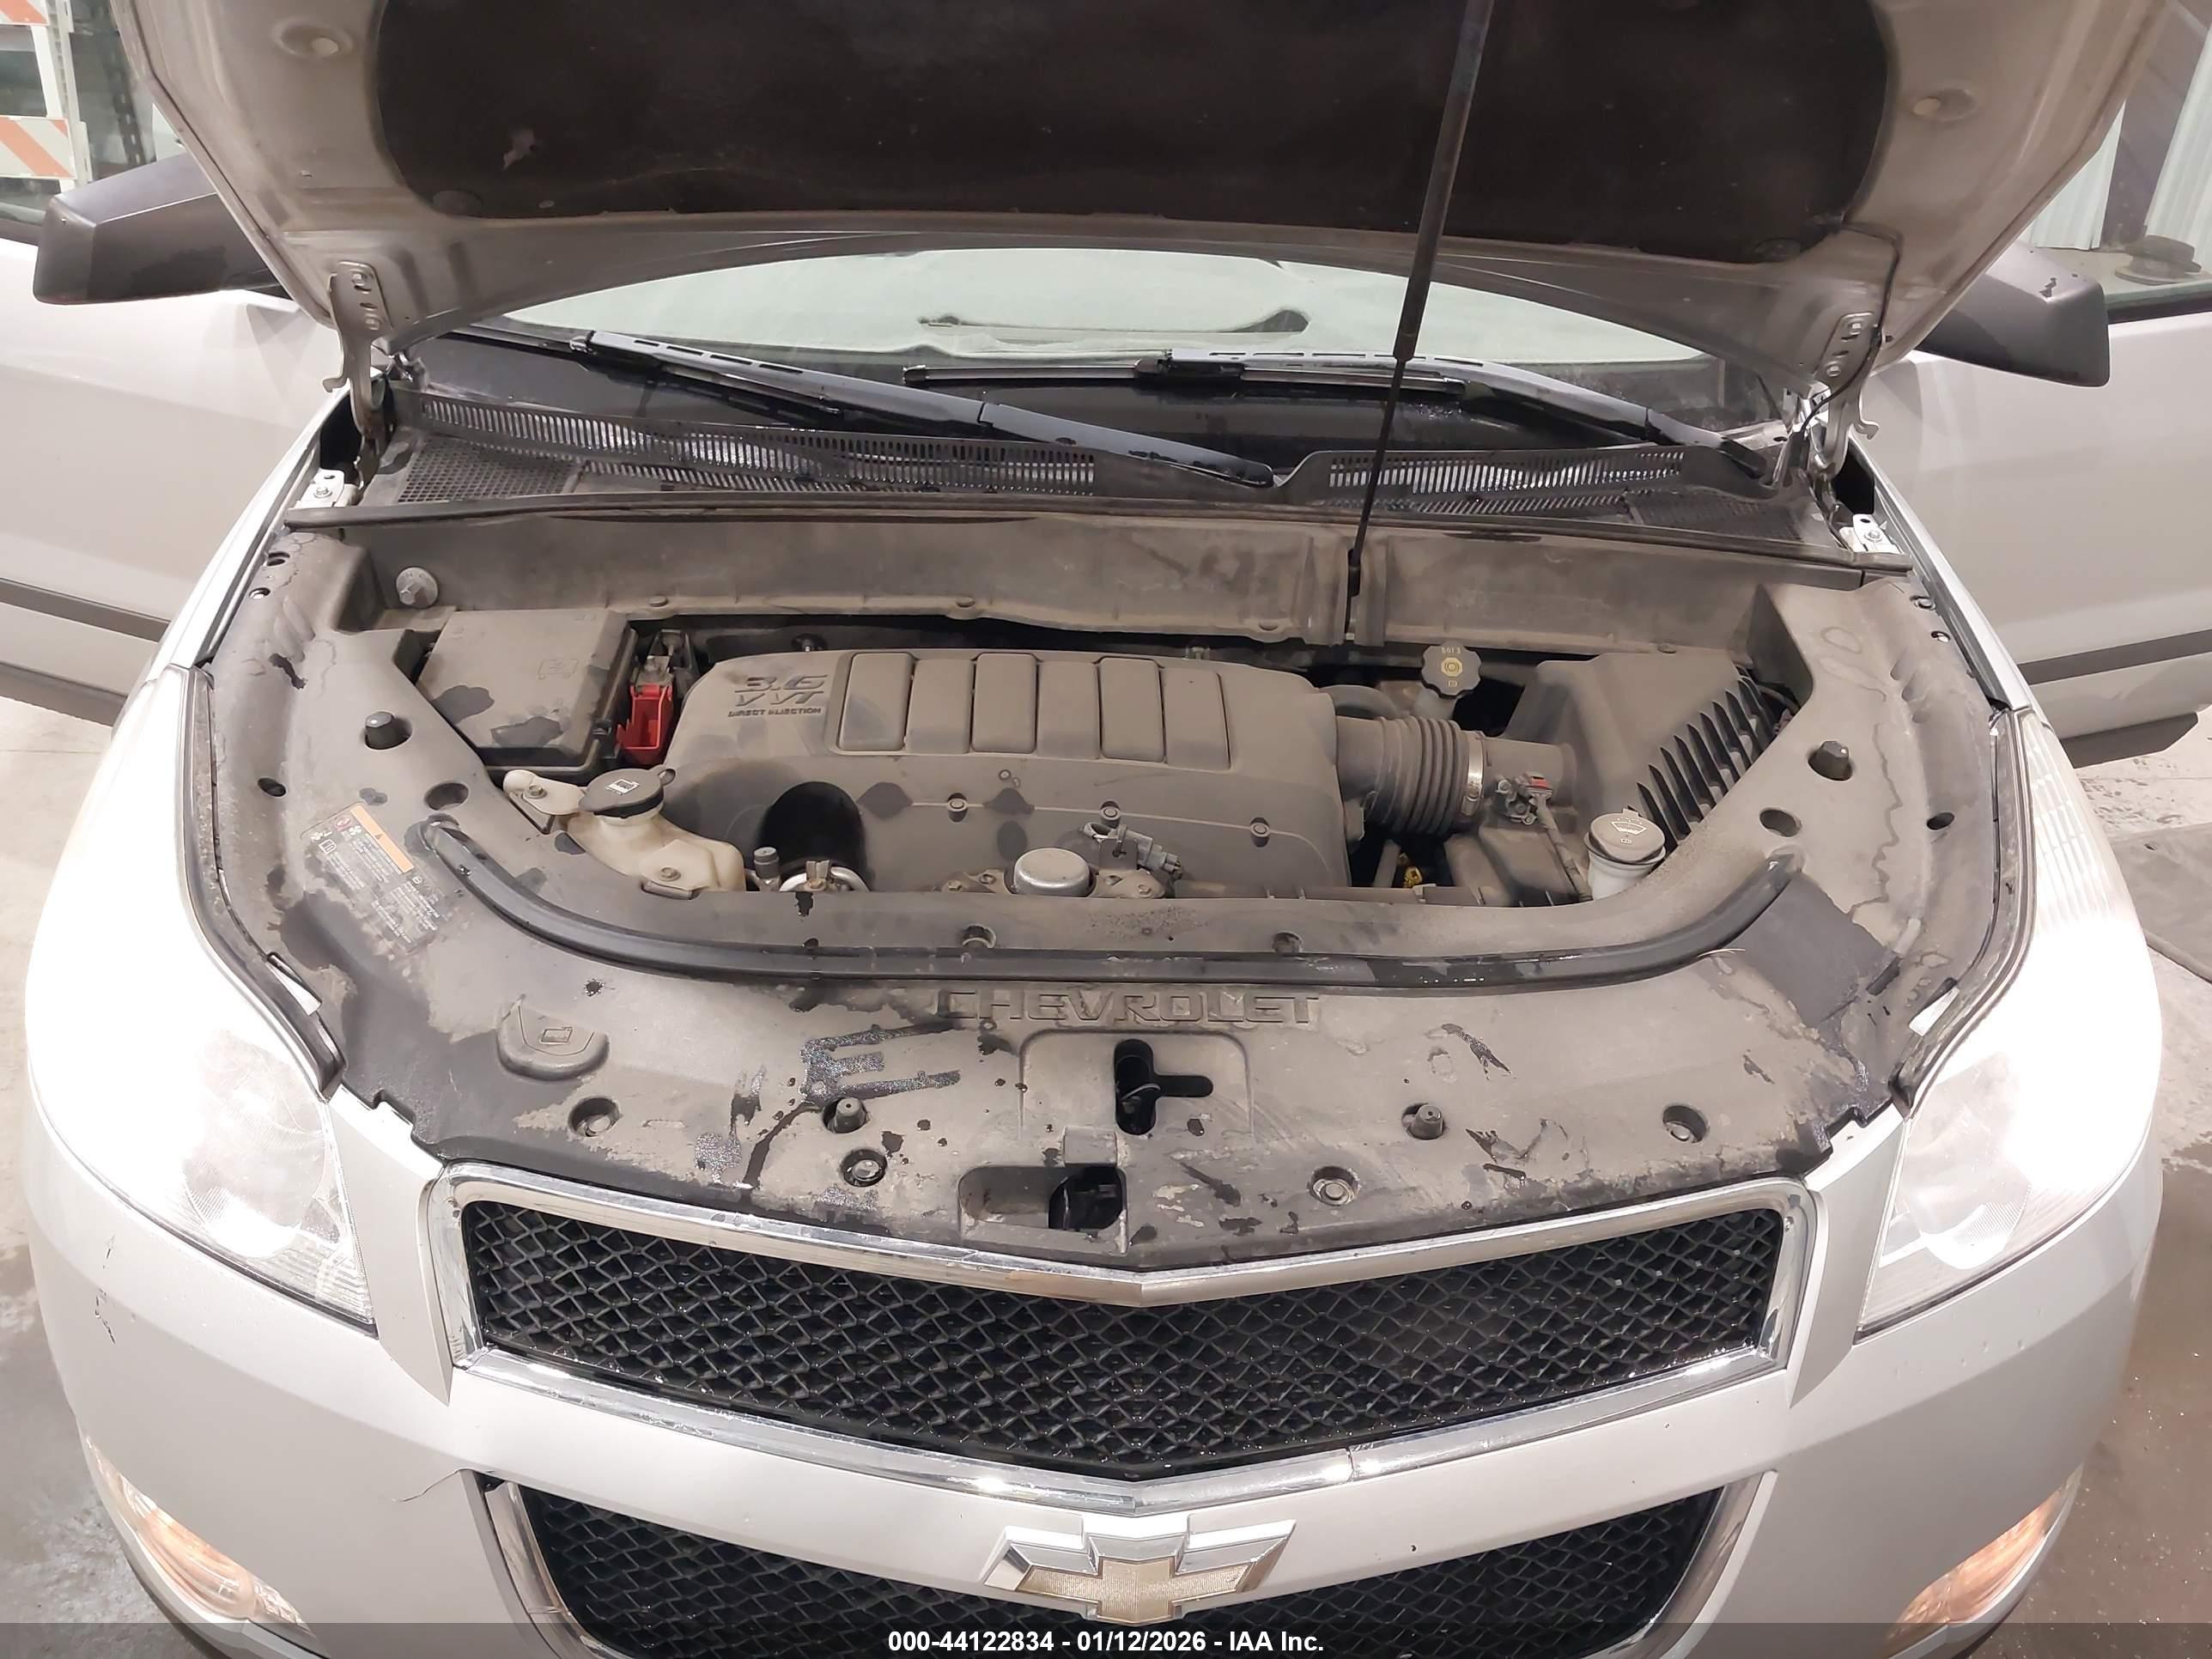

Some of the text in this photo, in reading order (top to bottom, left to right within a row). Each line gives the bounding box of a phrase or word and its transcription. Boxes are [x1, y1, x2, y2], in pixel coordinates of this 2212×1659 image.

[735, 674, 828, 693] 3.6
[735, 690, 824, 707] VVT
[727, 708, 822, 718] DIRECT INJECTION
[937, 988, 1320, 1024] CHEVROLET
